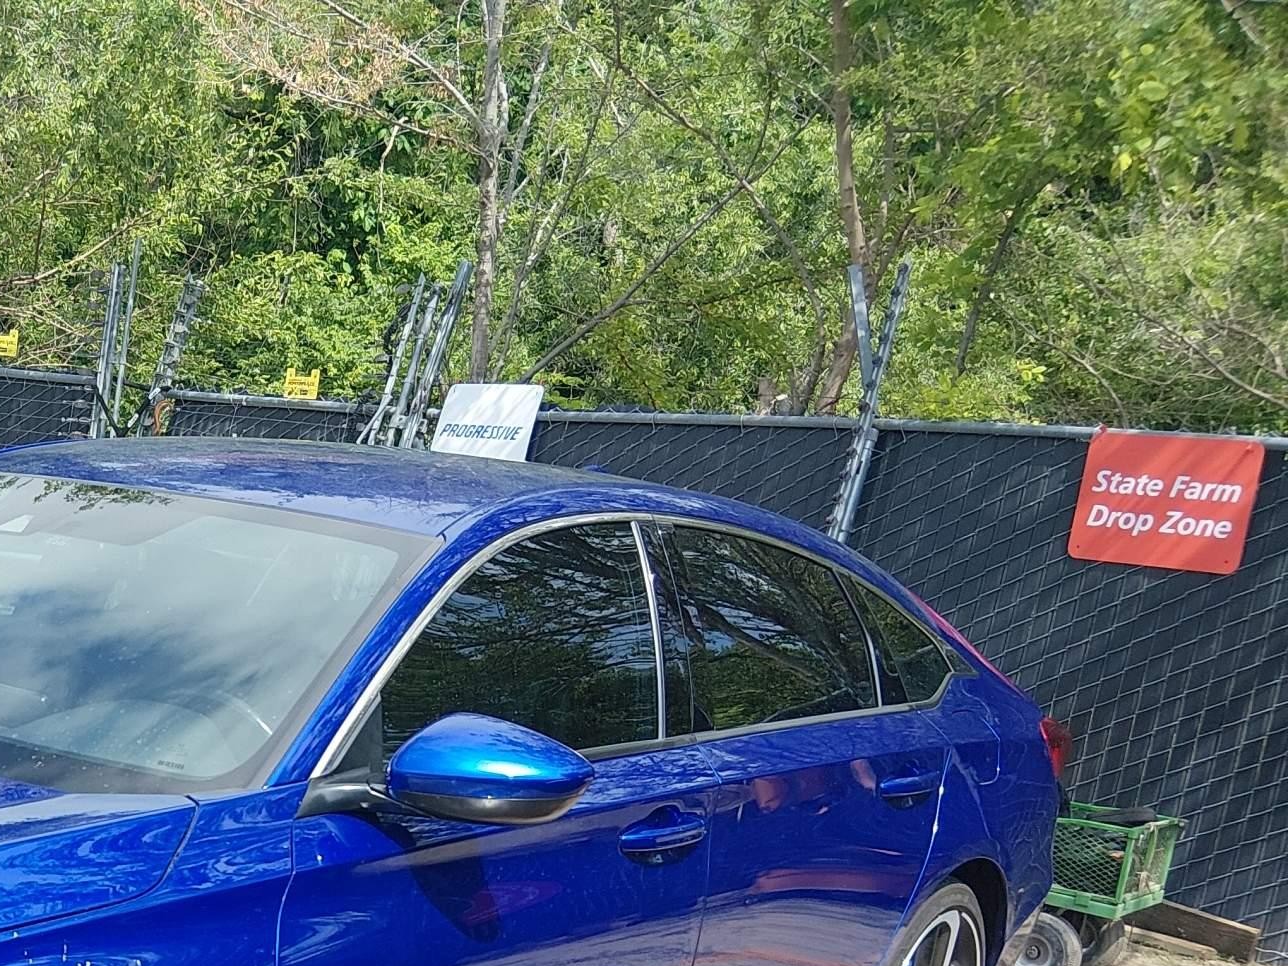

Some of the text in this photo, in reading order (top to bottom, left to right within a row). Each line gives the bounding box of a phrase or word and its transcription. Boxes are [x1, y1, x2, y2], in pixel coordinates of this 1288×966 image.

[439, 423, 524, 441] PROGRESSIVE
[1091, 469, 1243, 503] State Farm
[1085, 504, 1233, 539] Drop Zone
